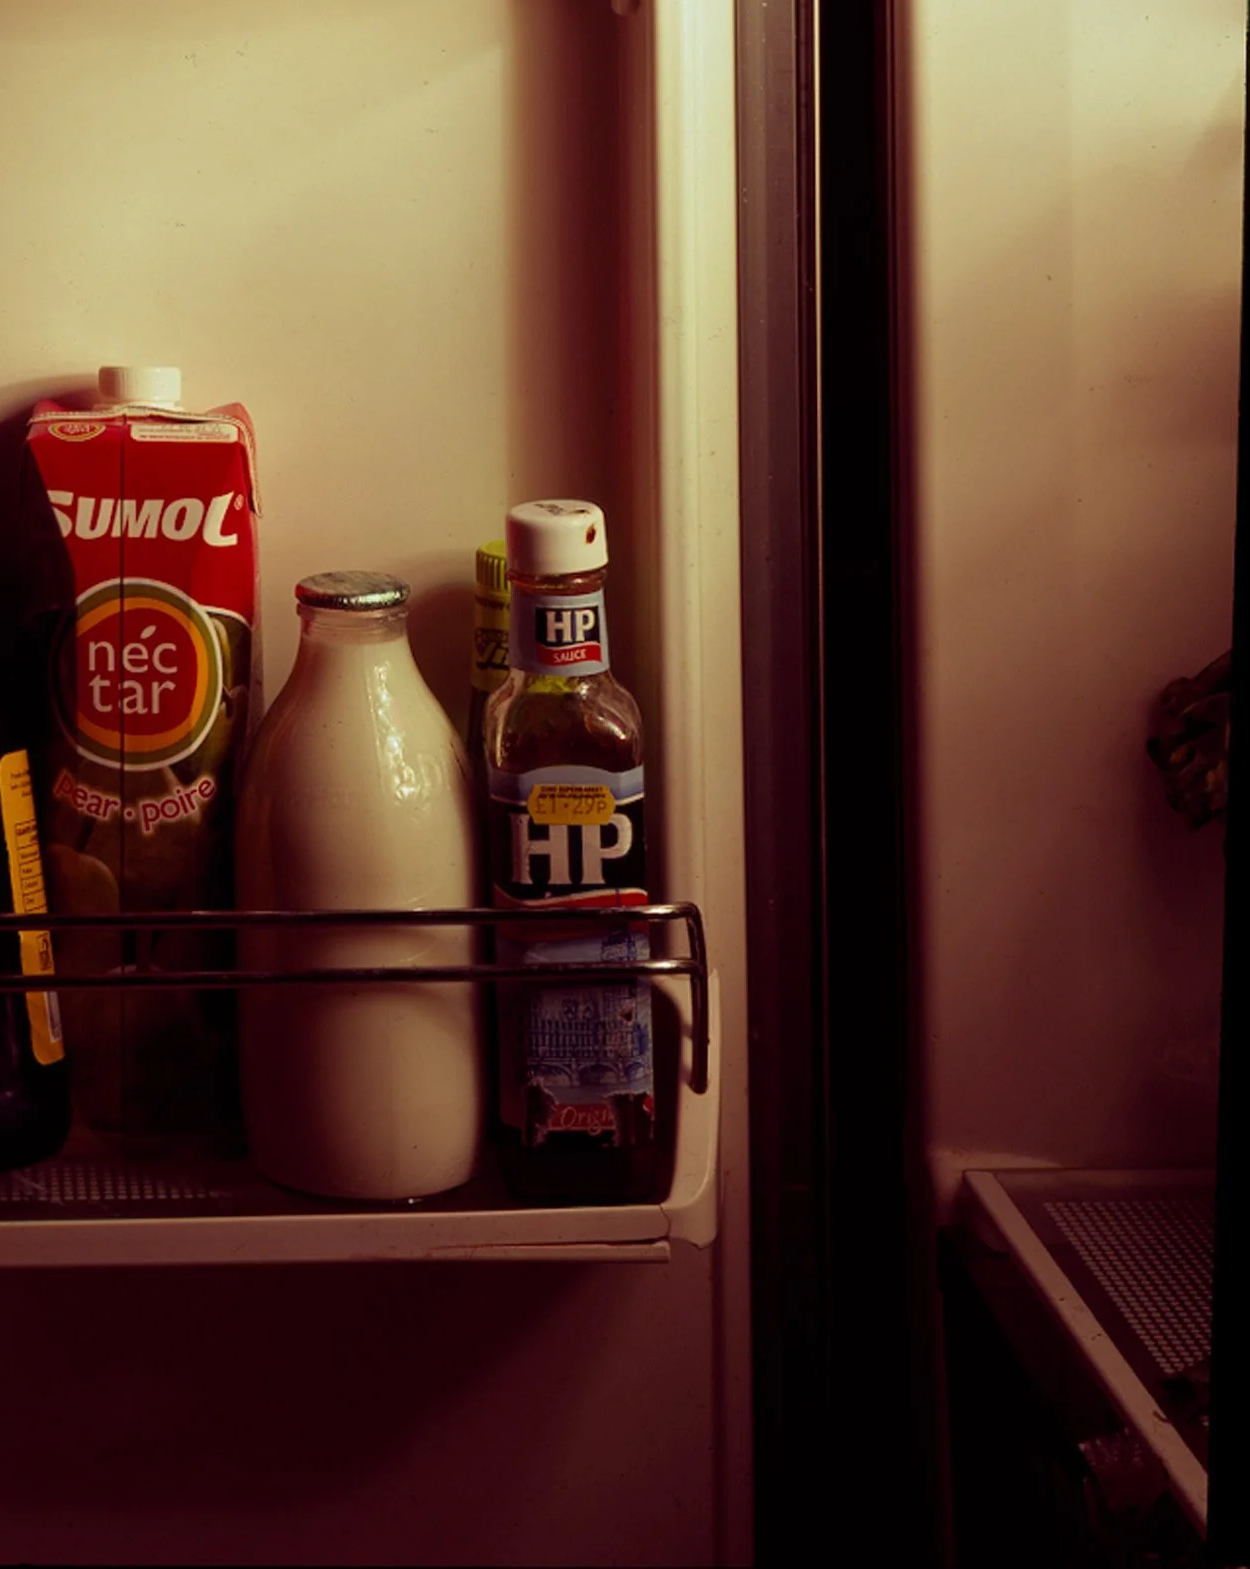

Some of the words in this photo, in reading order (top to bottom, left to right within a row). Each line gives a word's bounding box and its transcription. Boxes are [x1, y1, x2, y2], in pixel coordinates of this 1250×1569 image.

[46, 489, 239, 548] SUMOL
[87, 624, 178, 675] néc
[545, 609, 596, 644] HP
[552, 648, 588, 664] SAUCE
[87, 674, 177, 715] tar
[56, 770, 118, 819] pear
[142, 778, 215, 831] poire
[508, 812, 634, 885] HP
